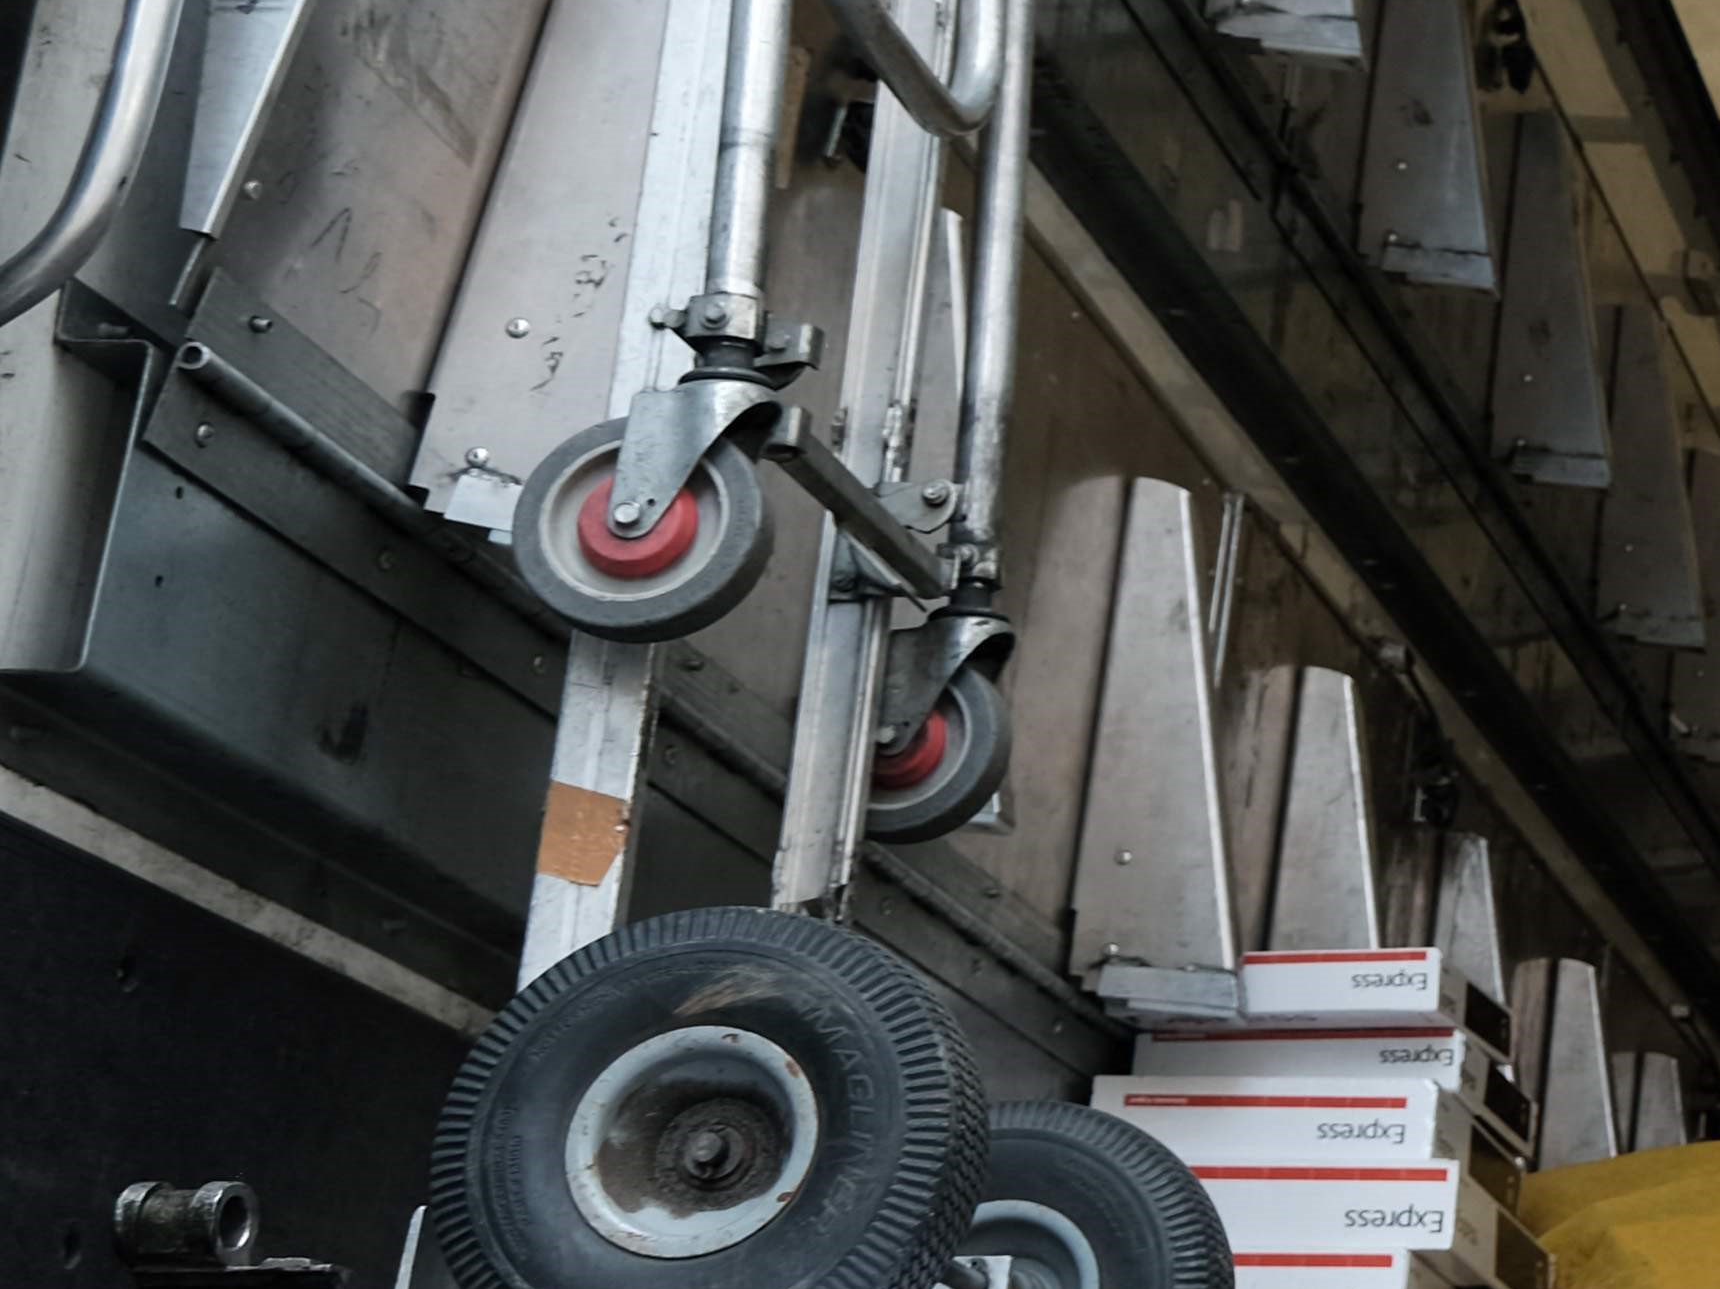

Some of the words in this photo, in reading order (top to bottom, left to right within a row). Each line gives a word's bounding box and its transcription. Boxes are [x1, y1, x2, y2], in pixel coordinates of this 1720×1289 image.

[1351, 968, 1428, 991] Express
[1379, 1045, 1455, 1067] Express
[1317, 1119, 1406, 1144] Express
[1344, 1204, 1444, 1234] Express
